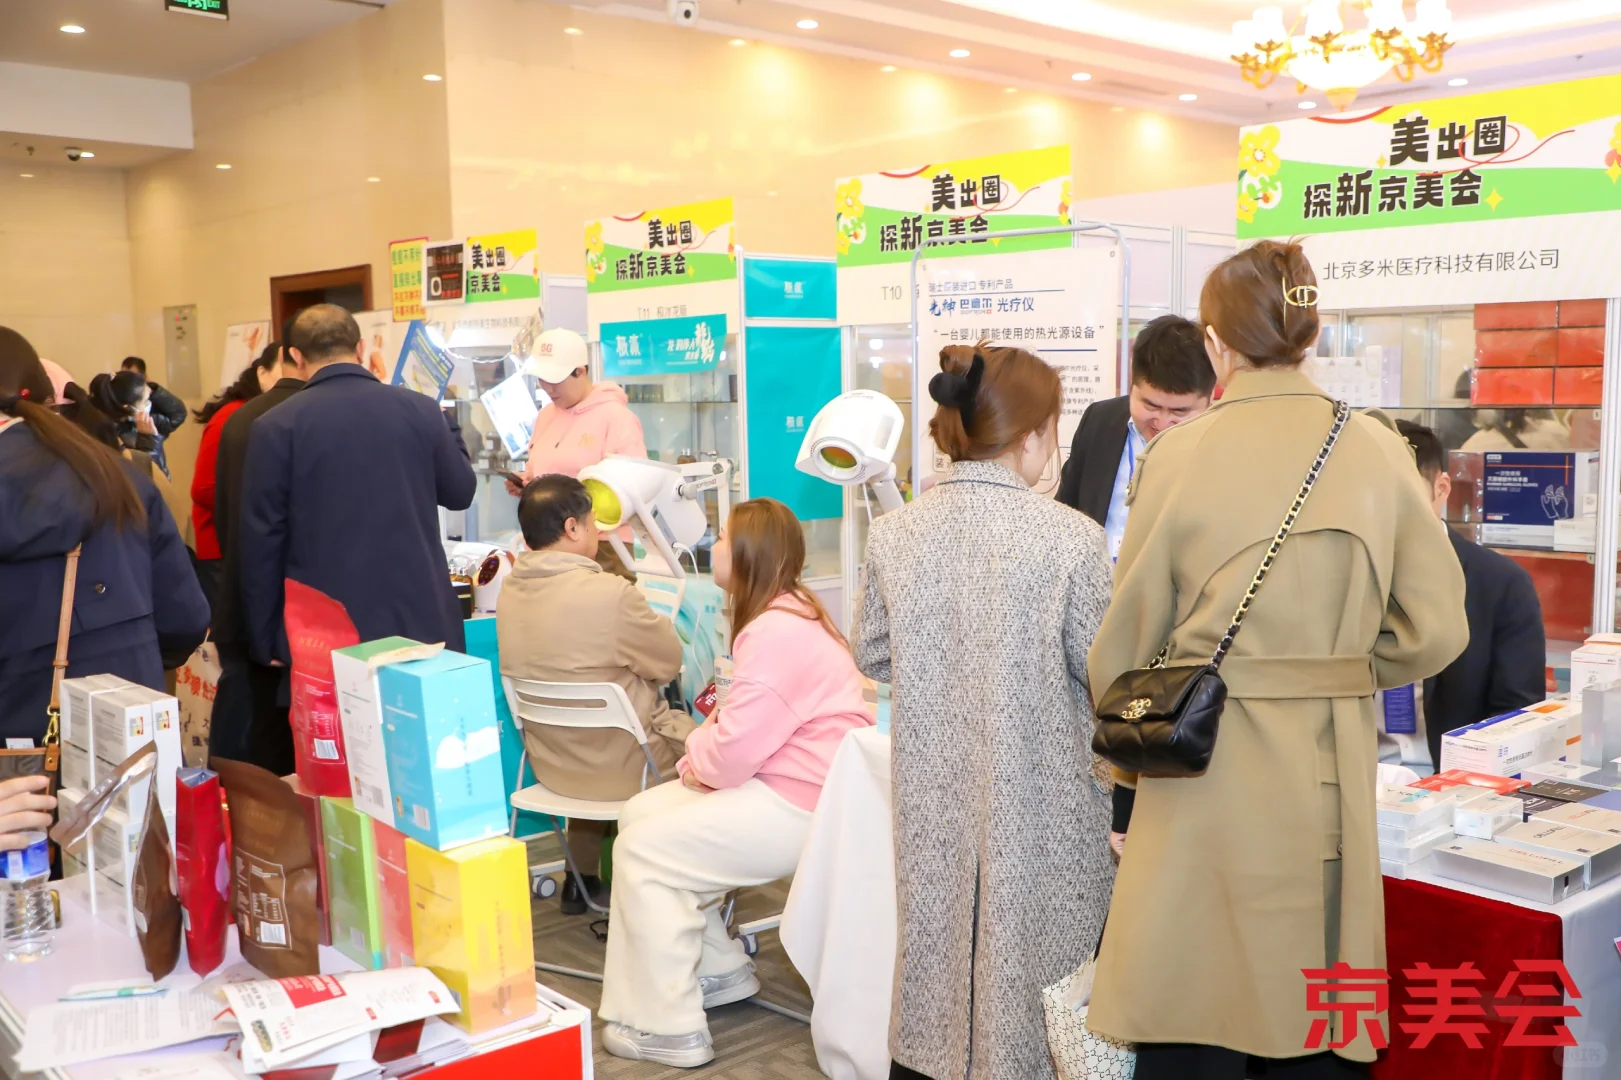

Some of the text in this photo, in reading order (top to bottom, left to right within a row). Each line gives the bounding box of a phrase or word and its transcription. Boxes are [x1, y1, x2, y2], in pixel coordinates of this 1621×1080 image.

[1390, 115, 1508, 166] 美出圈
[931, 173, 1002, 213] 美出圈
[1302, 169, 1483, 220] 探新京美会
[647, 219, 693, 249] 美出圈
[879, 215, 990, 253] 探新京美会
[471, 244, 506, 270] 美出圈
[615, 252, 687, 282] 探新京美会
[1322, 247, 1561, 281] 北京多米医疗科技有限公司
[880, 285, 903, 301] T10
[978, 278, 1013, 290] 专利产品
[997, 297, 1035, 313] 光疗仪
